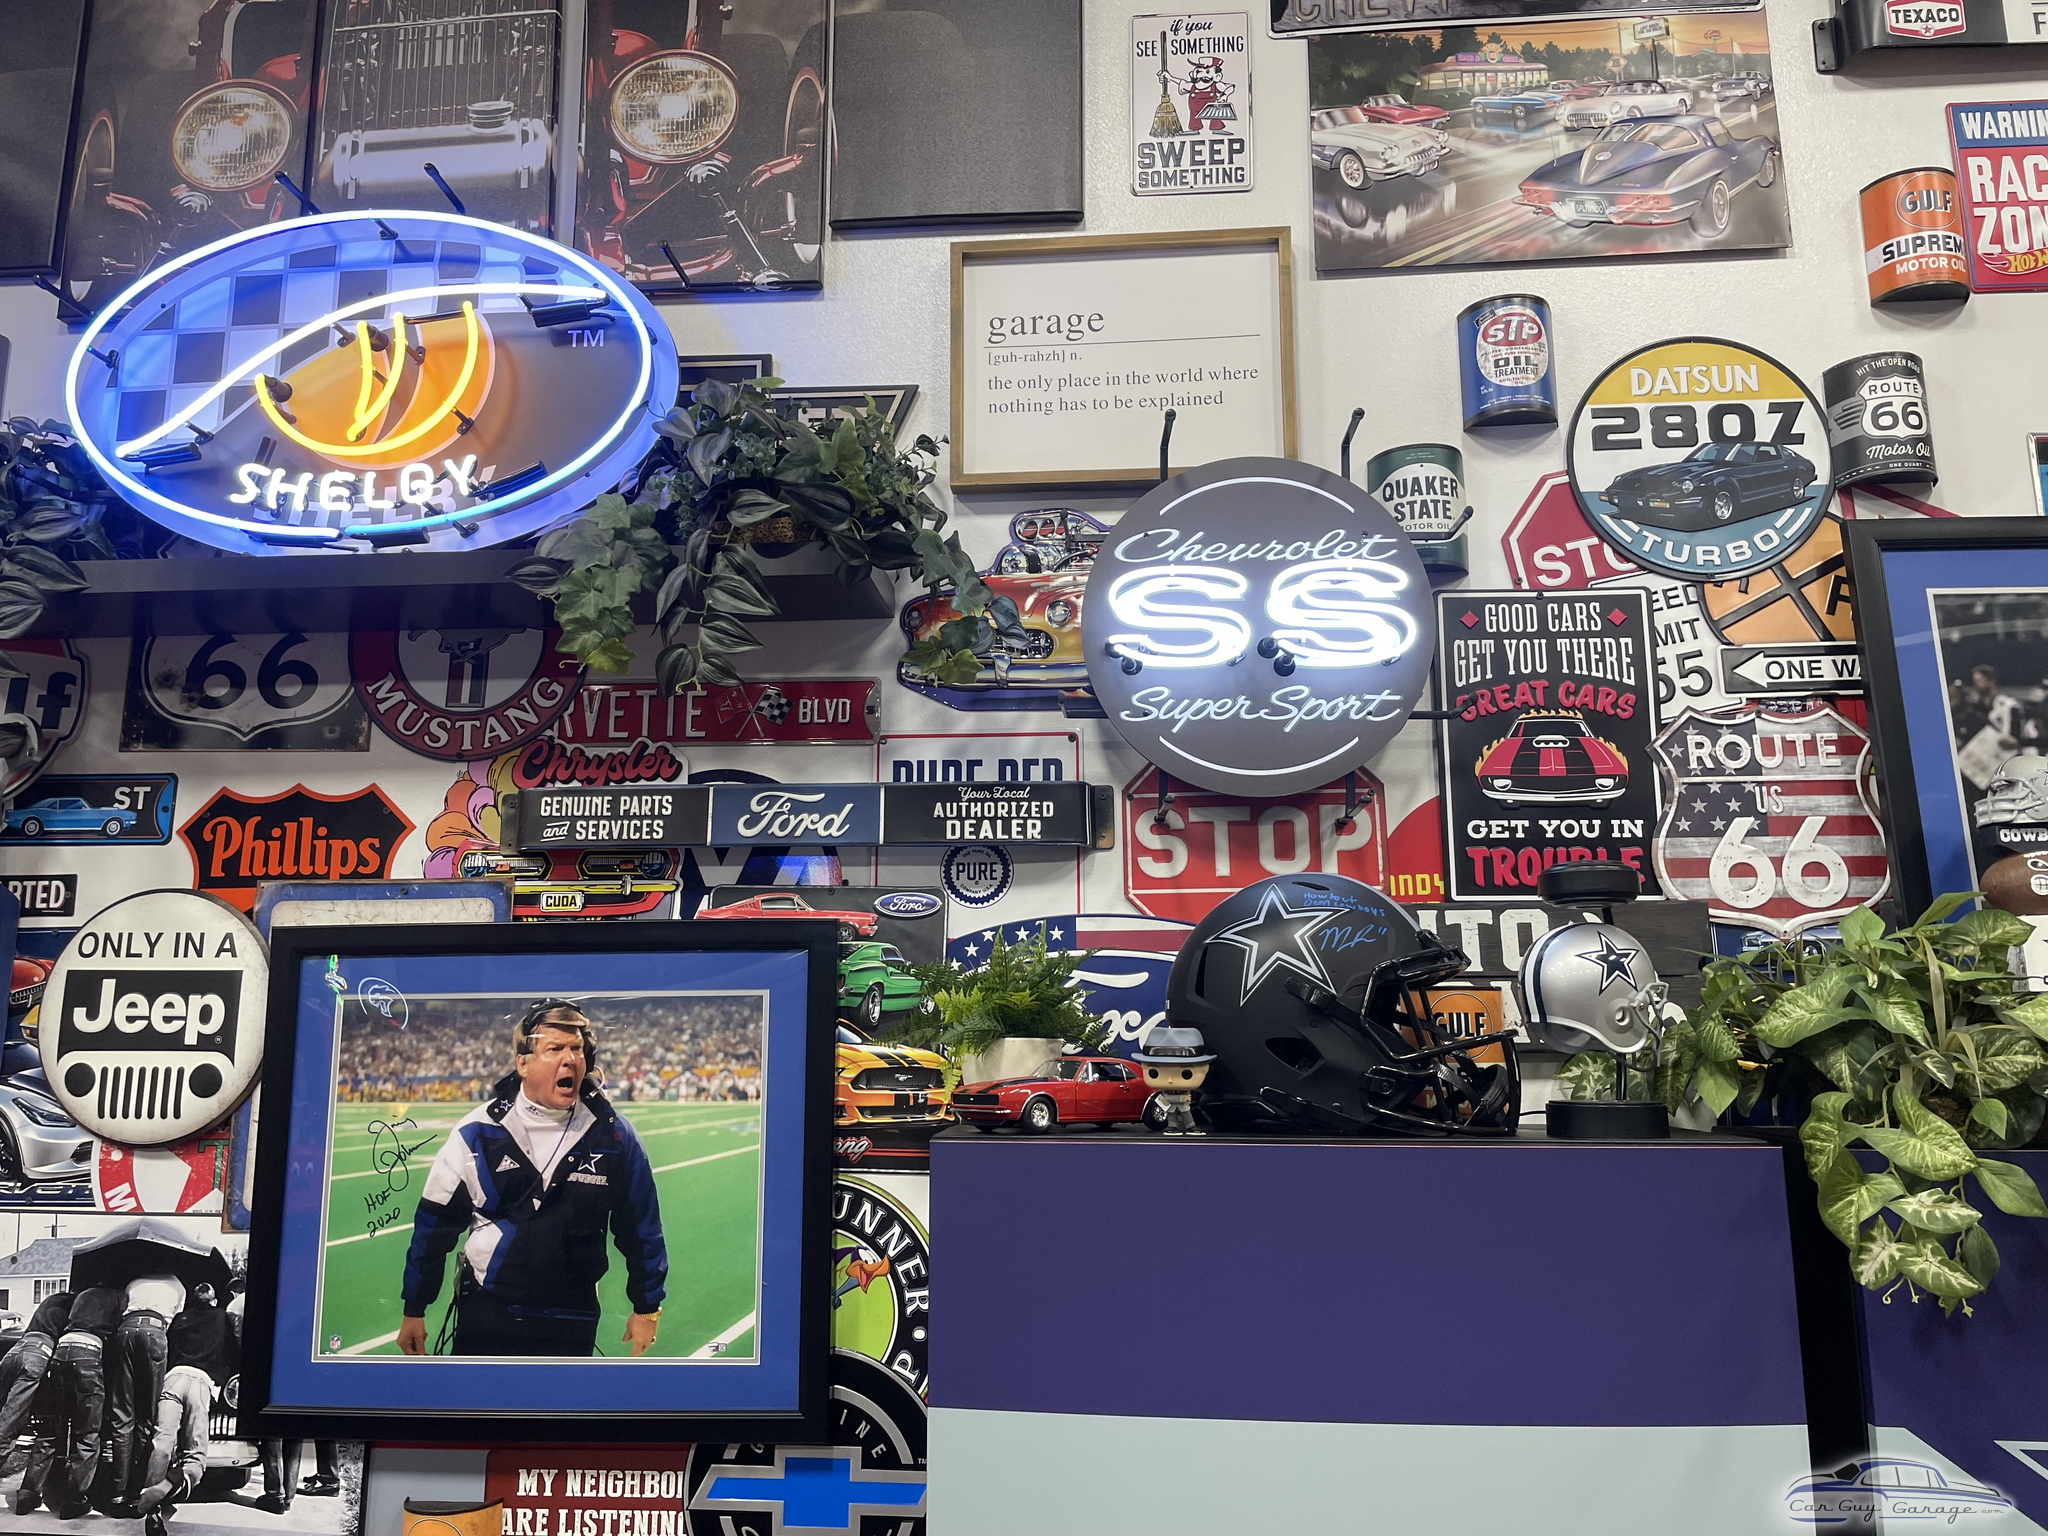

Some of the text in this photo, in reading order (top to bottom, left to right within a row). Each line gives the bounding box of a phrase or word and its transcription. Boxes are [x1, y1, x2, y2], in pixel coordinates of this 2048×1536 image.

[1170, 19, 1213, 36] if you
[1892, 8, 1960, 24] TEXACO
[1136, 35, 1244, 57] SEE SOMETHING
[1961, 110, 2048, 140] WARNIN
[1138, 138, 1245, 169] SWEEP
[1138, 167, 1245, 188] SOMETHING
[1972, 155, 2048, 203] RAC
[1901, 189, 1952, 214] GULF
[1974, 206, 2048, 254] ZON
[1883, 234, 1966, 263] SUPREM
[1896, 257, 1967, 275] MOTOR OIL
[568, 330, 604, 346] TM
[988, 311, 1105, 345] garage
[1486, 316, 1539, 343] STP
[988, 350, 1082, 366] [guh-rahzh] n.
[1493, 355, 1539, 369] OIL
[1494, 367, 1539, 378] TREATMENT
[1856, 358, 1921, 376] HIT THE OPEN ROAD
[988, 365, 1259, 394] the only place in the world where
[1630, 364, 1759, 396] DATSUN
[1868, 382, 1919, 395] ROUTE
[988, 390, 1224, 416] nothing has to be explained
[1870, 401, 1924, 431] 66
[1591, 401, 1805, 451] 280Z
[1866, 442, 1931, 459] Motor Oil
[230, 453, 477, 512] SHELBY
[1382, 475, 1459, 503] QUAKER
[1113, 528, 1399, 563] Chevrolet
[1640, 528, 1781, 566] TURBO
[1107, 556, 1418, 669] SS
[1484, 602, 1603, 634] GOOD CARS
[185, 633, 319, 710] 66
[1453, 637, 1637, 688] GET YOU THERE
[1765, 658, 1861, 680] ONE W
[366, 672, 564, 751] MUSTANG
[798, 697, 851, 725] BLVD
[1119, 685, 1402, 733] Super Sport
[1456, 679, 1637, 722] GREAT CARS
[511, 738, 682, 790] Chrysler
[1687, 732, 1842, 769] ROUTE
[114, 786, 151, 810] ST
[540, 795, 673, 817] GENUINE PARTS
[957, 786, 1030, 802] Your Local
[1754, 785, 1785, 814] US
[737, 791, 854, 838] Ford
[933, 801, 1055, 818] AUTHORIZED
[542, 820, 664, 841] and SERVICES
[946, 819, 1042, 840] DEALER
[1134, 805, 1373, 879] STOP
[1466, 820, 1643, 838] GET YOU IN
[202, 815, 381, 881] Phillips
[1709, 816, 1849, 909] 66
[956, 862, 998, 880] PURE
[1465, 846, 1647, 887] TROE
[8, 880, 66, 909] RTED
[546, 892, 577, 910] CUDA
[890, 896, 926, 911] Ford
[77, 931, 238, 958] ONLY IN A
[72, 978, 226, 1046] Jeep
[1432, 1012, 1486, 1038] GULF
[364, 1187, 391, 1213] HOF
[366, 1207, 401, 1238] 2020
[516, 1468, 559, 1497] MY
[502, 1507, 550, 1536] ARE
